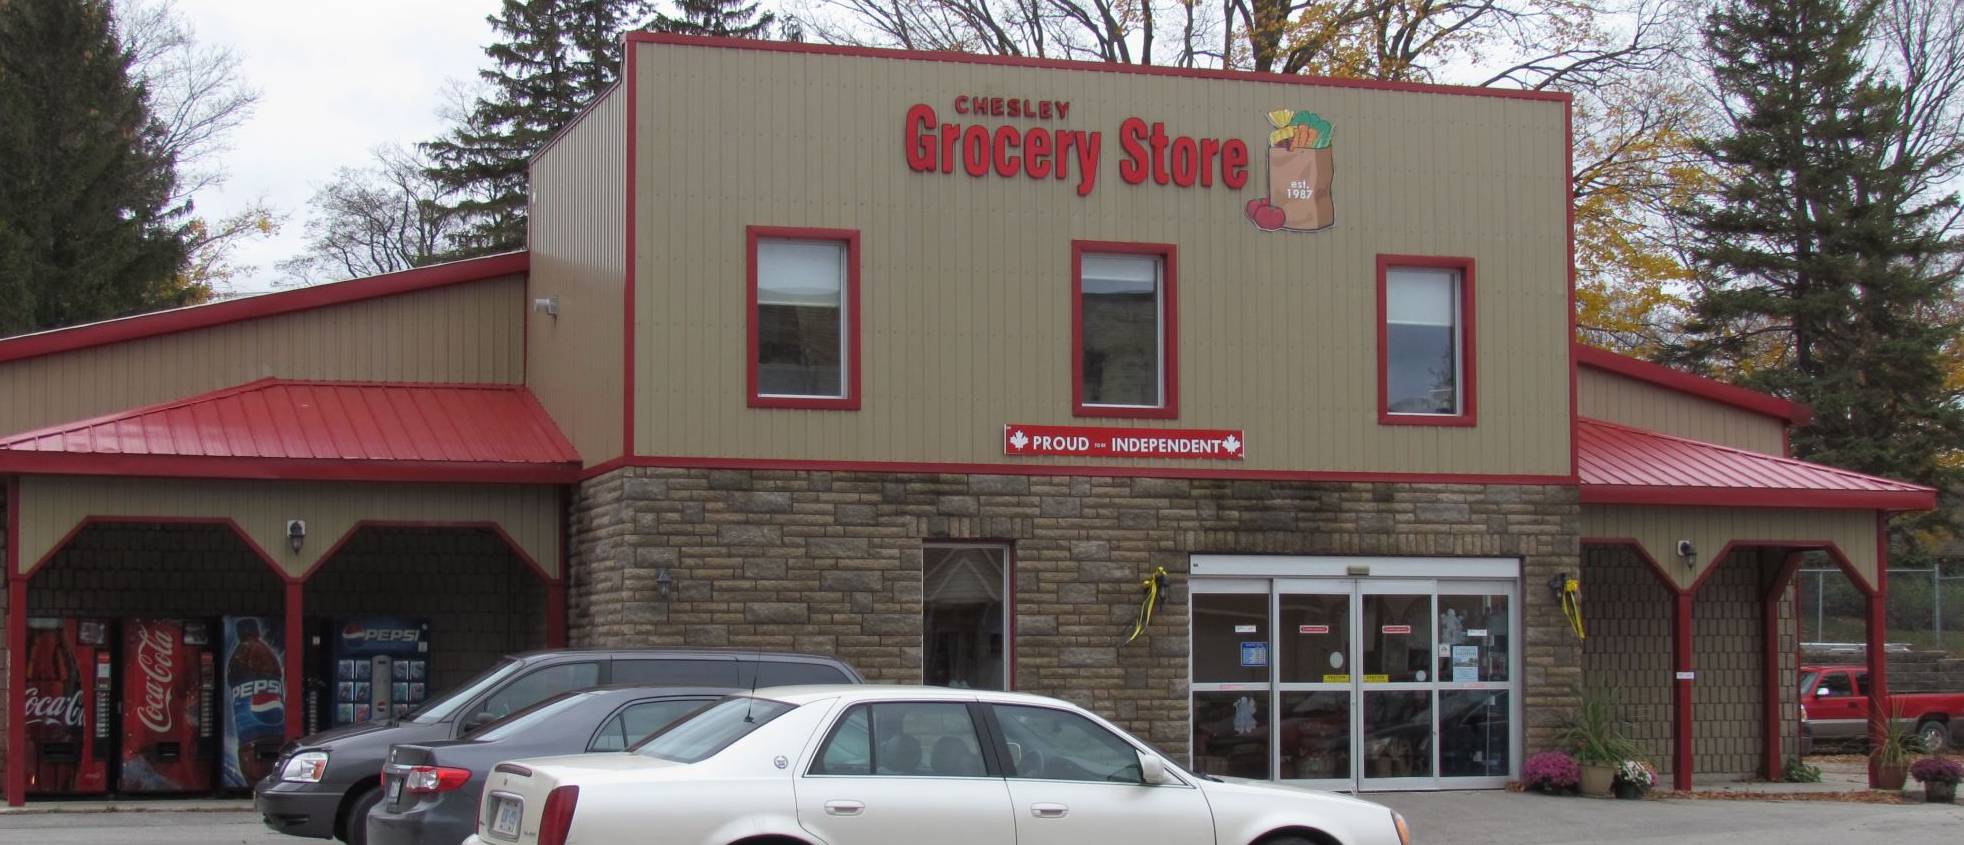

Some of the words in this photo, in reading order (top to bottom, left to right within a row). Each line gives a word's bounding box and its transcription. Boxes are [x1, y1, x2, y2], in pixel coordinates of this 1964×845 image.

[954, 95, 1071, 120] CHESLEY
[905, 103, 1102, 197] Grocery
[1118, 116, 1249, 190] Store
[1290, 179, 1310, 189] est.
[1287, 188, 1313, 199] 1987
[1032, 435, 1090, 451] PROUD
[1111, 437, 1222, 454] INDEPENDENT
[364, 629, 420, 641] PEPSI
